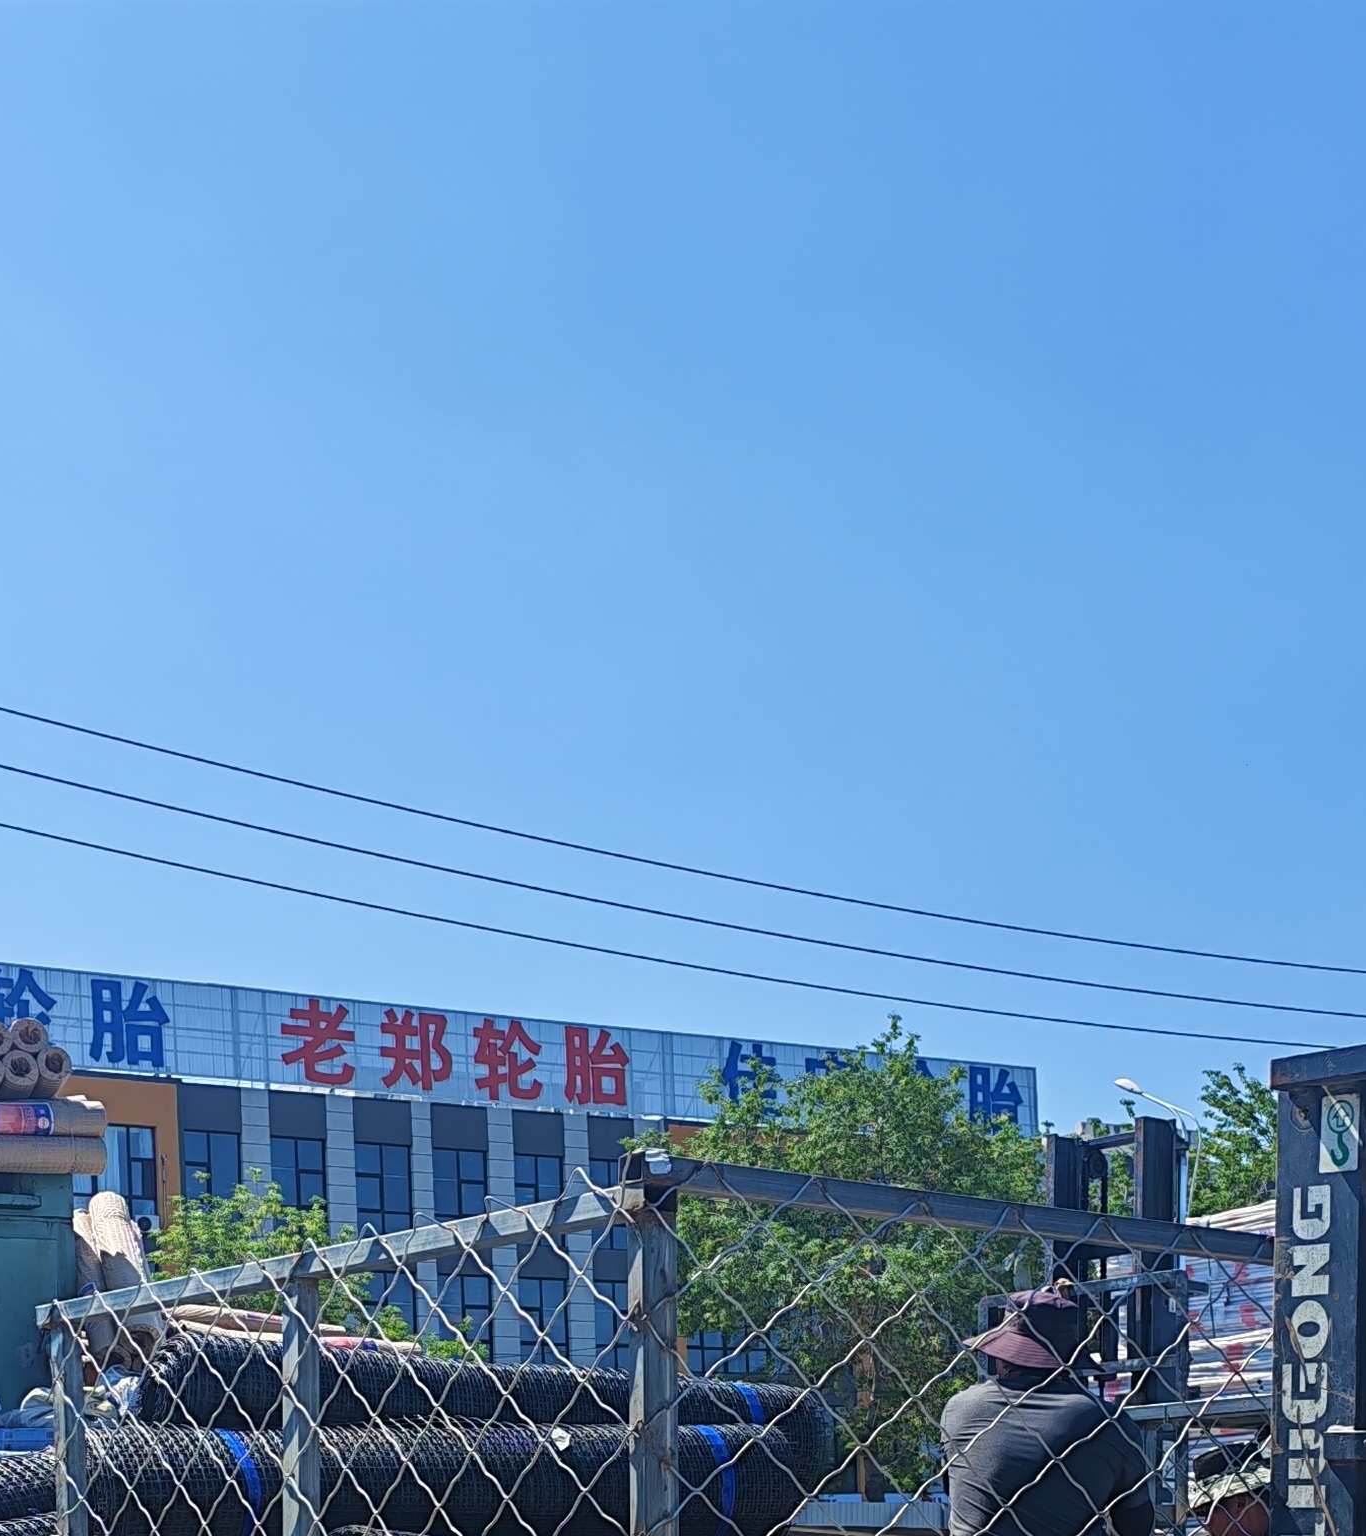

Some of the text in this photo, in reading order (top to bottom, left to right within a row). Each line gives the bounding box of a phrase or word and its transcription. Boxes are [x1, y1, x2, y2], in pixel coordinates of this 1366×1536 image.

[280, 998, 631, 1108] 老郑轮胎
[721, 1040, 1024, 1135] 佳胎
